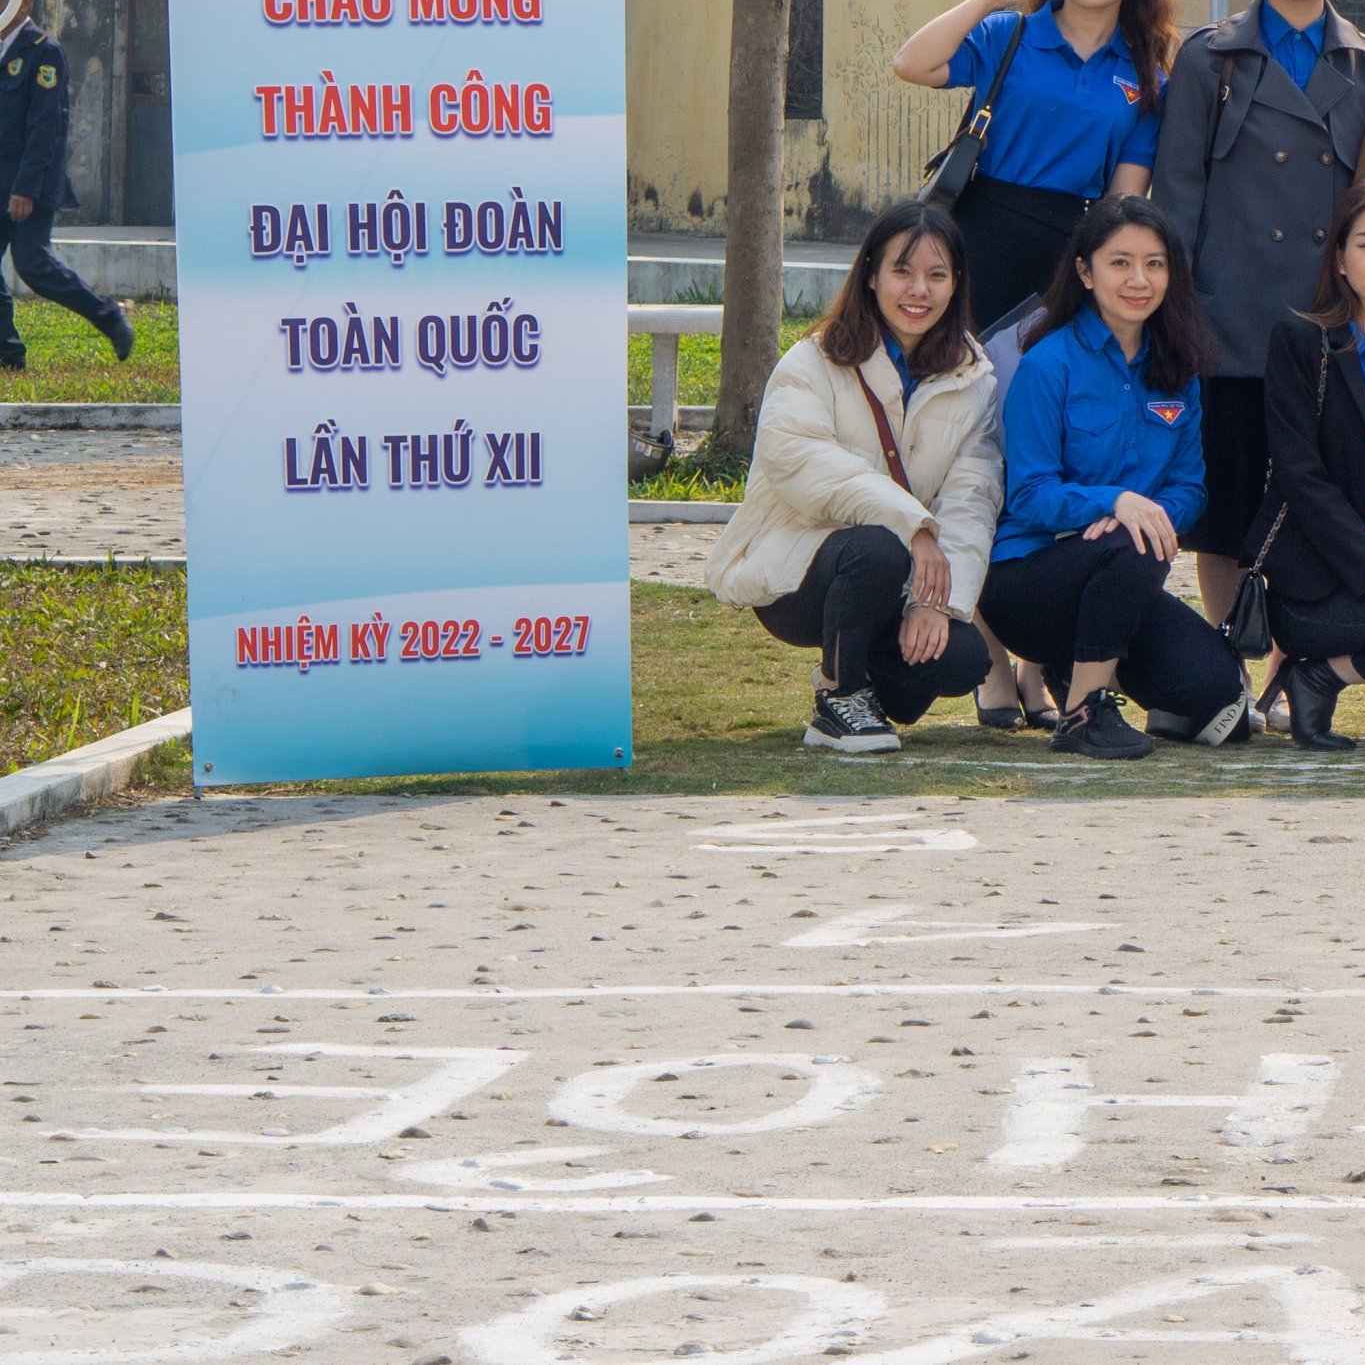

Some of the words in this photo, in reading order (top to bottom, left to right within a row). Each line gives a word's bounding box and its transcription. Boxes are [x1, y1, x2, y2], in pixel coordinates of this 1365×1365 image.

[255, 70, 412, 136] THÀNH
[429, 69, 553, 135] CÔNG
[249, 203, 330, 265] ĐẠI
[347, 189, 428, 264] HỘI
[443, 186, 563, 253] ĐOÀN
[280, 302, 400, 369] TOÀN
[417, 297, 540, 374] QUỐC
[285, 419, 369, 489] LẦN
[383, 418, 473, 485] THỨ
[485, 431, 542, 483] XII
[236, 616, 340, 670] NHIỆM
[350, 612, 391, 661] KỲ
[401, 619, 480, 658] 2022
[515, 614, 591, 654] 2027
[1214, 709, 1237, 734] FIND
